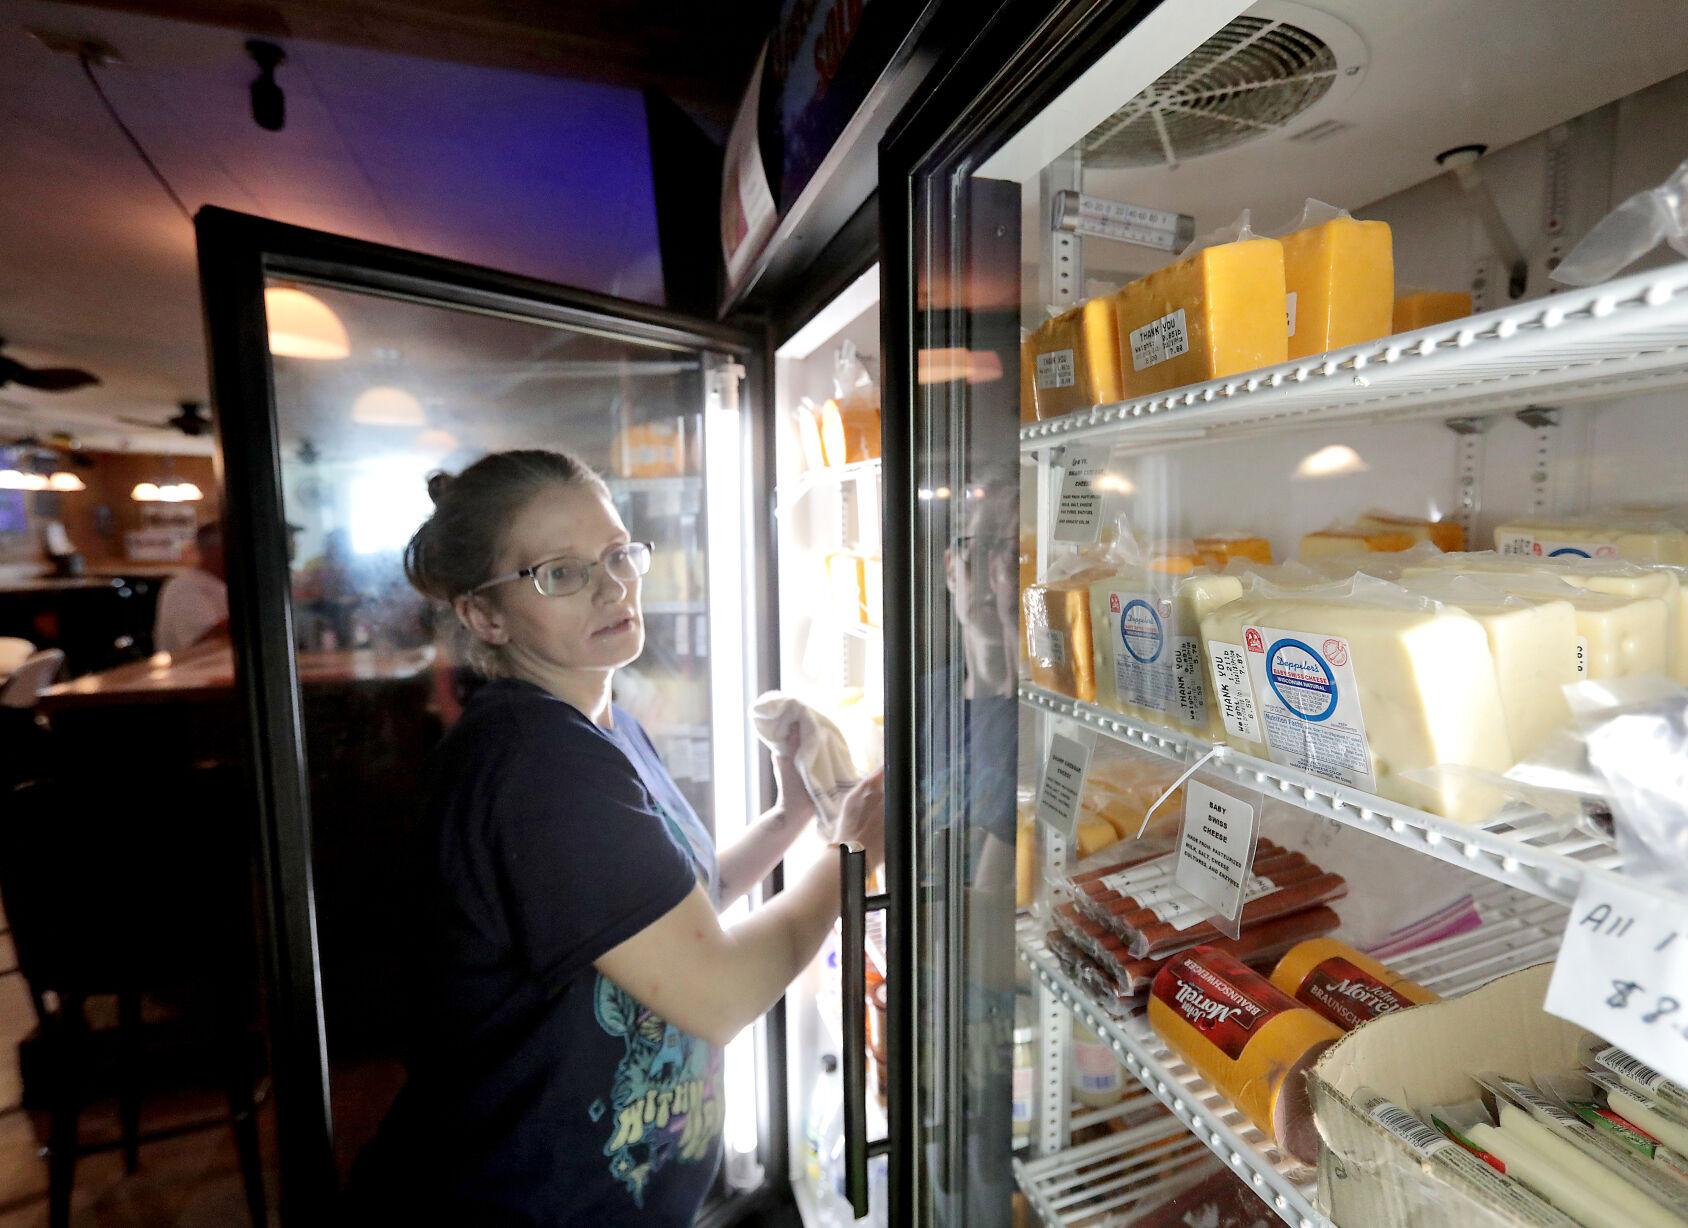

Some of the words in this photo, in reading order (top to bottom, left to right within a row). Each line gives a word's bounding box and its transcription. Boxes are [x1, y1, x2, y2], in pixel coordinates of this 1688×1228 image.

[1140, 326, 1160, 341] THANK
[1162, 318, 1176, 332] YOU
[1175, 650, 1183, 670] YOU
[1215, 656, 1227, 677] YOU
[1277, 676, 1303, 686] WISCONSIN
[1287, 671, 1305, 680] SWISS
[1304, 674, 1327, 684] CHEESE
[1177, 676, 1188, 708] THANK
[1221, 684, 1235, 718] THANK
[1209, 801, 1227, 815] BABY
[1208, 814, 1228, 829] SWISS
[1202, 825, 1228, 843] CHEESE
[1187, 833, 1199, 844] MADE
[1212, 848, 1242, 869] PASTEURIZED
[1208, 865, 1219, 875] AND
[1211, 857, 1230, 871] CHEESE
[1579, 903, 1635, 938] All
[1183, 958, 1262, 1016] BRAUNSCHWEIGER
[1175, 979, 1242, 1023] Morrell
[1310, 984, 1361, 1025] BRAUNSCH
[1181, 1001, 1206, 1023] John
